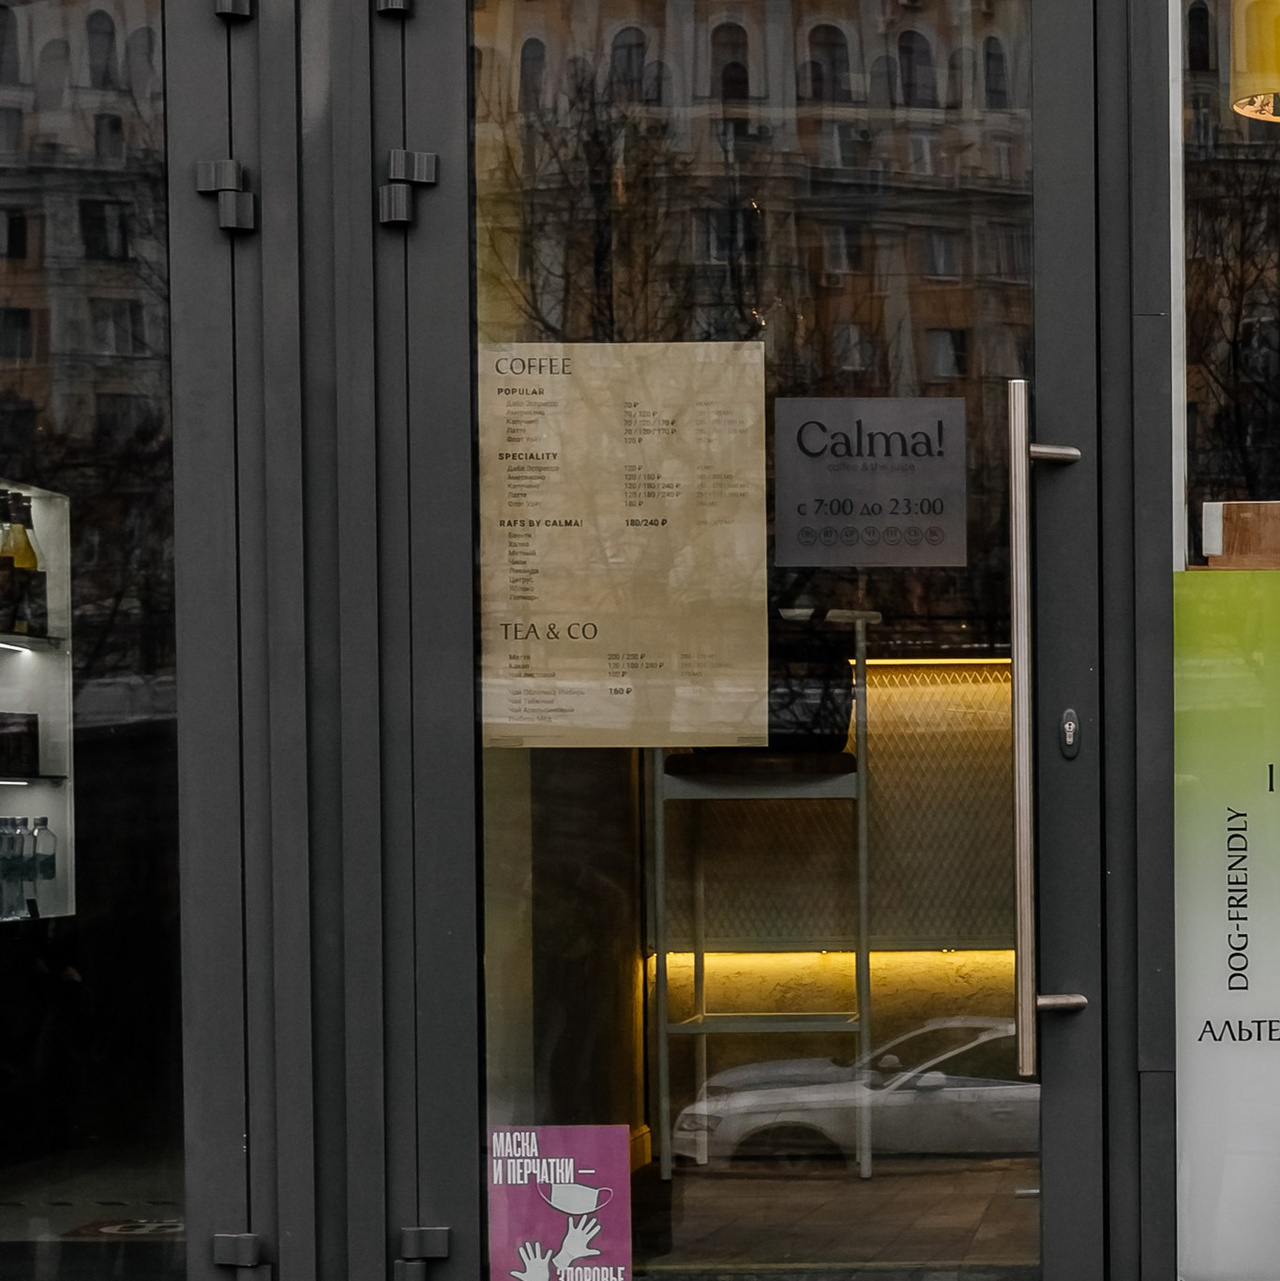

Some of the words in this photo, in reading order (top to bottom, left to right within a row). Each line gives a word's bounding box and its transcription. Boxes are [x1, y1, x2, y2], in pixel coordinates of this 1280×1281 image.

[494, 357, 573, 376] COFFEE
[497, 387, 545, 396] POPULAR
[623, 401, 632, 409] 70
[623, 410, 632, 418] 70
[624, 428, 632, 436] 70
[796, 418, 945, 458] Calma!
[498, 452, 558, 461] SPECIALITY
[797, 503, 807, 516] с
[814, 498, 854, 516] 7:00
[859, 503, 883, 516] до
[889, 497, 945, 516] 23:00
[499, 519, 526, 528] RAFS
[528, 519, 542, 528] BY
[544, 519, 584, 528] CALMA!
[625, 518, 659, 527] 180/240
[499, 623, 541, 640] TEA
[546, 623, 560, 640] &
[567, 622, 598, 640] CO
[1227, 806, 1249, 992] DOG-FRIENDLY
[492, 1132, 539, 1157] МАСКА
[493, 1160, 503, 1184] И
[507, 1158, 575, 1184] ПЕРЧАТКИ
